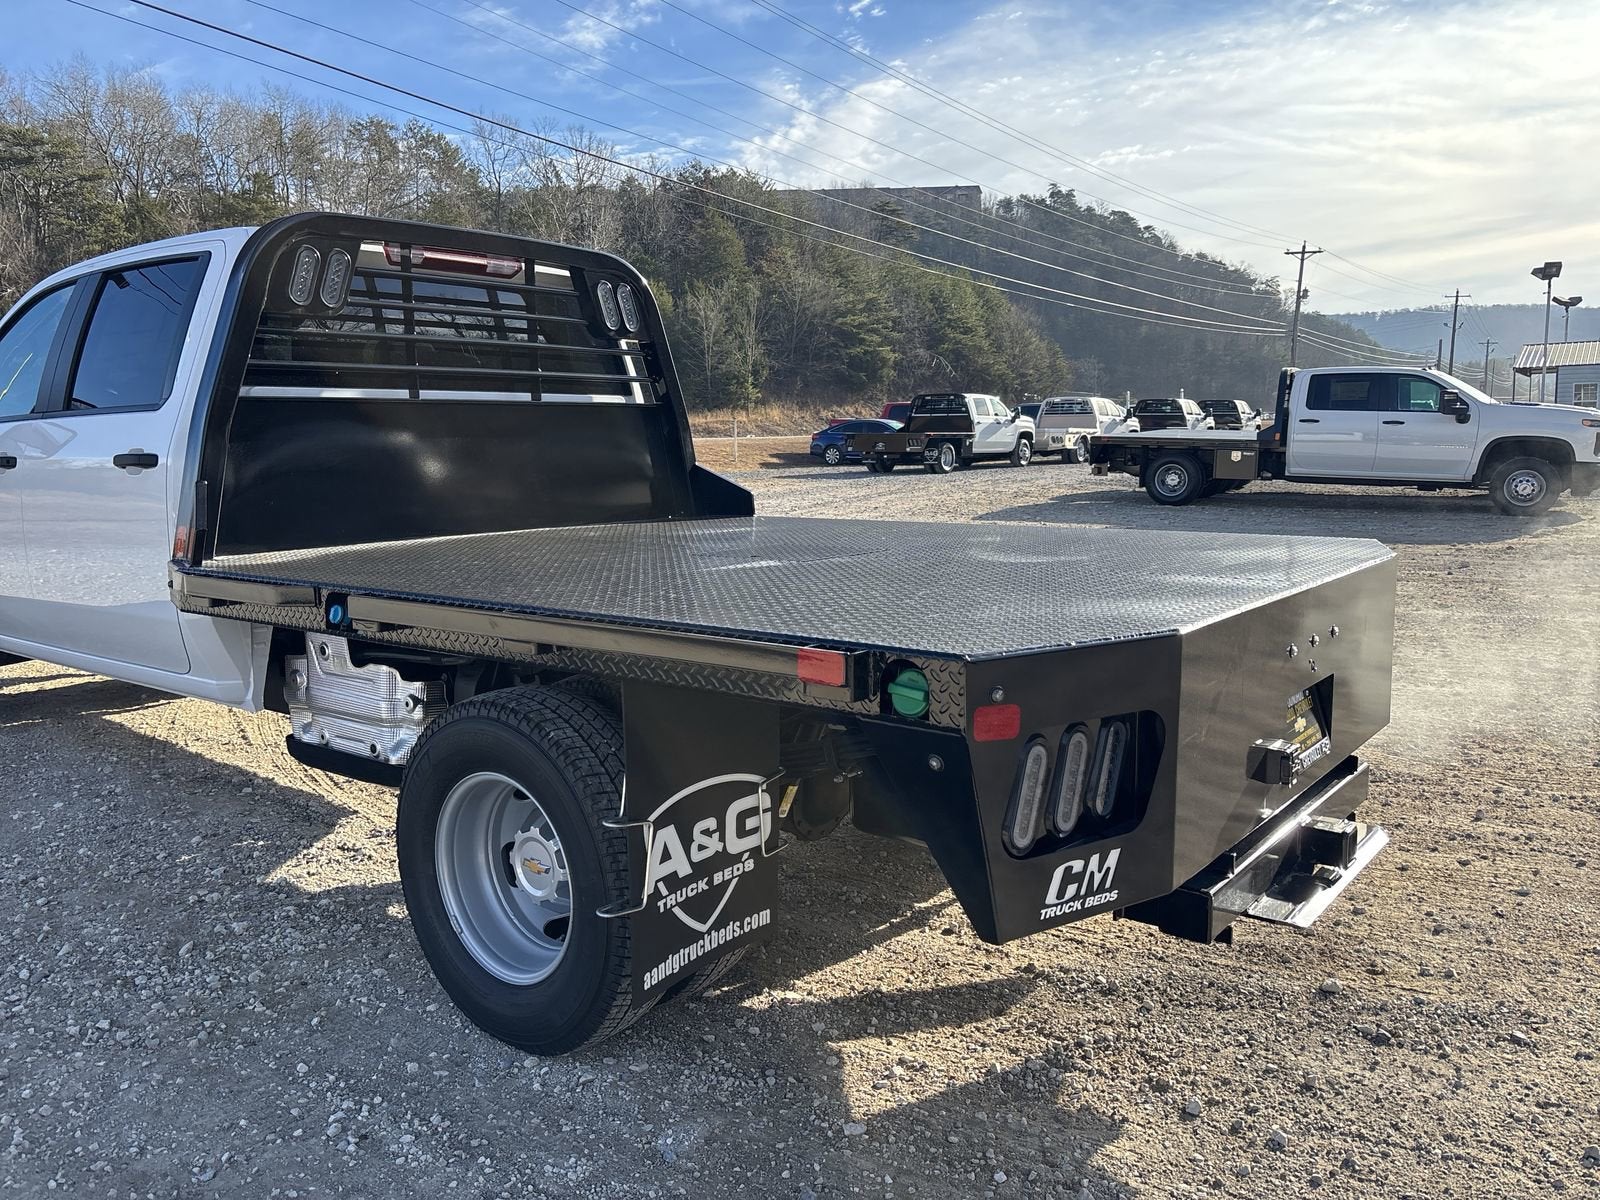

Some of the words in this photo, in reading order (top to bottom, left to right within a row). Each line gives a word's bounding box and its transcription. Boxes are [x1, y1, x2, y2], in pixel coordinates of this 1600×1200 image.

[641, 791, 772, 899] A&G
[657, 877, 710, 912] TRUCK
[713, 858, 755, 886] BEDS
[1040, 899, 1083, 920] TRUCK
[1084, 890, 1119, 908] BEDS
[1046, 847, 1122, 905] CM
[643, 908, 771, 991] aandgtruckbeds.com
